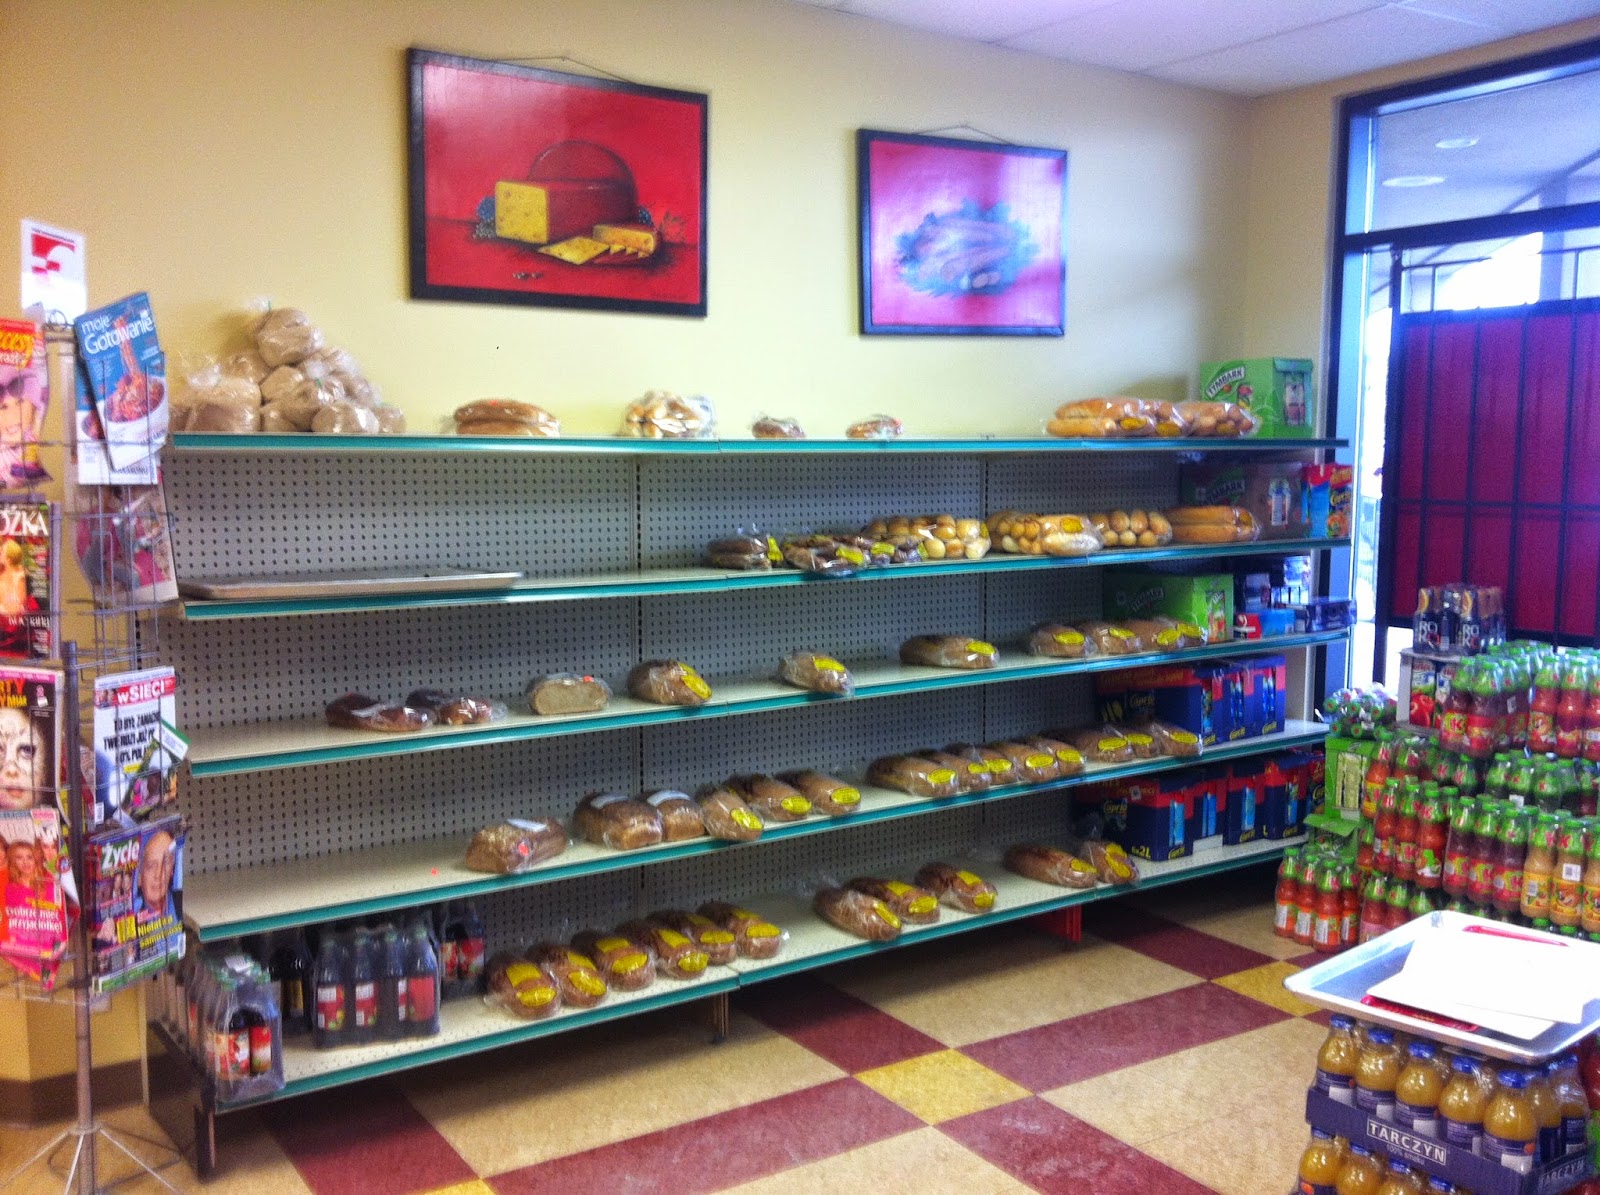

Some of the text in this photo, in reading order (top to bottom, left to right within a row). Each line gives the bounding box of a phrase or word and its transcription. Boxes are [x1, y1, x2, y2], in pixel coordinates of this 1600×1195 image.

[81, 315, 113, 335] moje
[84, 316, 154, 354] Gotowanie
[1208, 367, 1244, 397] TYMBARK
[117, 680, 165, 704] wSIECI
[1370, 1123, 1445, 1162] TARCZYN
